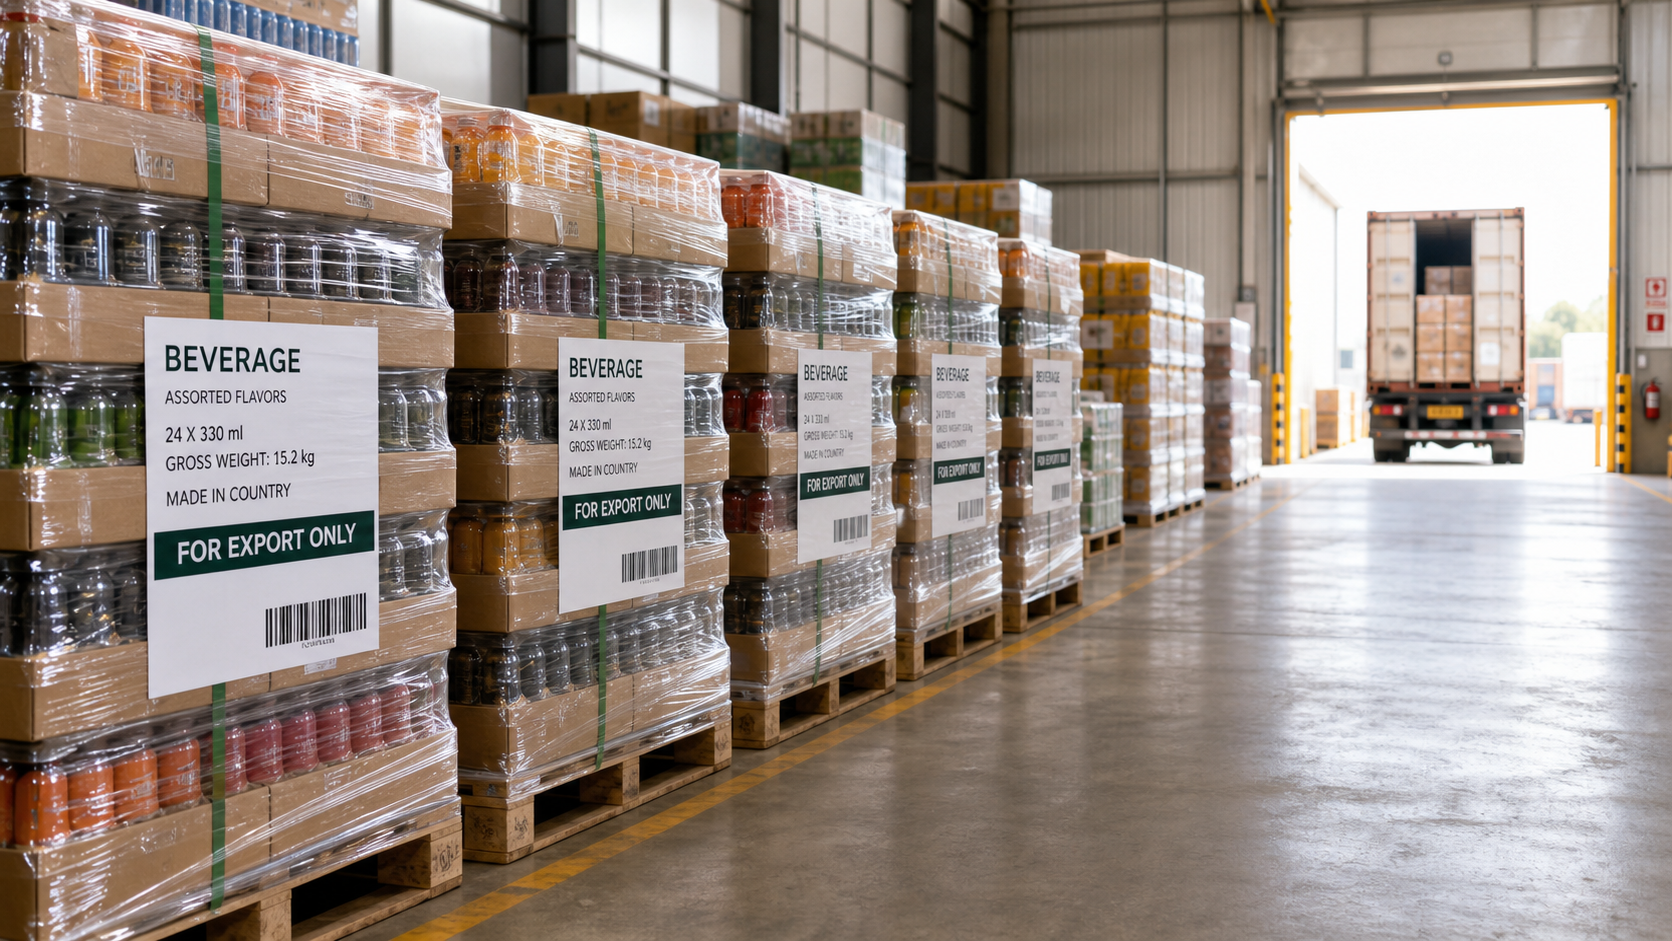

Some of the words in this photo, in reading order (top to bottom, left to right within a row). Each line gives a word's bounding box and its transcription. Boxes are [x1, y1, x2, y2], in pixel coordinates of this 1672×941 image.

[165, 344, 300, 373] BEVERAGE
[569, 357, 643, 378] BEVERAGE
[804, 364, 848, 381] BEVERAGE
[936, 367, 969, 382] BEVERAGE
[165, 390, 232, 404] ASSORTED
[235, 389, 286, 404] FLAVORS
[569, 392, 605, 403] ASSORTED
[607, 392, 635, 402] FLAVORS
[569, 419, 578, 431] 24
[580, 419, 586, 431] X
[588, 419, 600, 431] 330
[602, 418, 611, 430] ml
[166, 427, 182, 442] 24
[186, 426, 196, 442] X
[200, 426, 224, 441] 330
[228, 425, 243, 440] ml
[569, 440, 595, 452] GROSS
[596, 439, 626, 451] WEIGHT:
[628, 438, 642, 450] 15.2
[644, 438, 651, 451] kg
[166, 455, 211, 471] GROSS
[216, 452, 270, 468] WEIGHT:
[274, 450, 297, 465] 15.2
[301, 449, 314, 467] kg
[569, 465, 592, 478] MADE
[594, 464, 602, 476] IN
[604, 462, 638, 475] COUNTRY
[938, 466, 948, 478] FOR
[807, 478, 821, 492] FOR
[822, 475, 847, 490] EXPORT
[848, 473, 865, 487] ONLY
[166, 489, 207, 506] MADE
[212, 488, 225, 503] IN
[230, 483, 291, 501] COUNTRY
[575, 502, 598, 520] FOR
[602, 496, 643, 517] EXPORT
[645, 493, 671, 511] ONLY
[178, 538, 222, 564] FOR
[228, 529, 304, 558] EXPORT
[309, 523, 356, 548] ONLY
